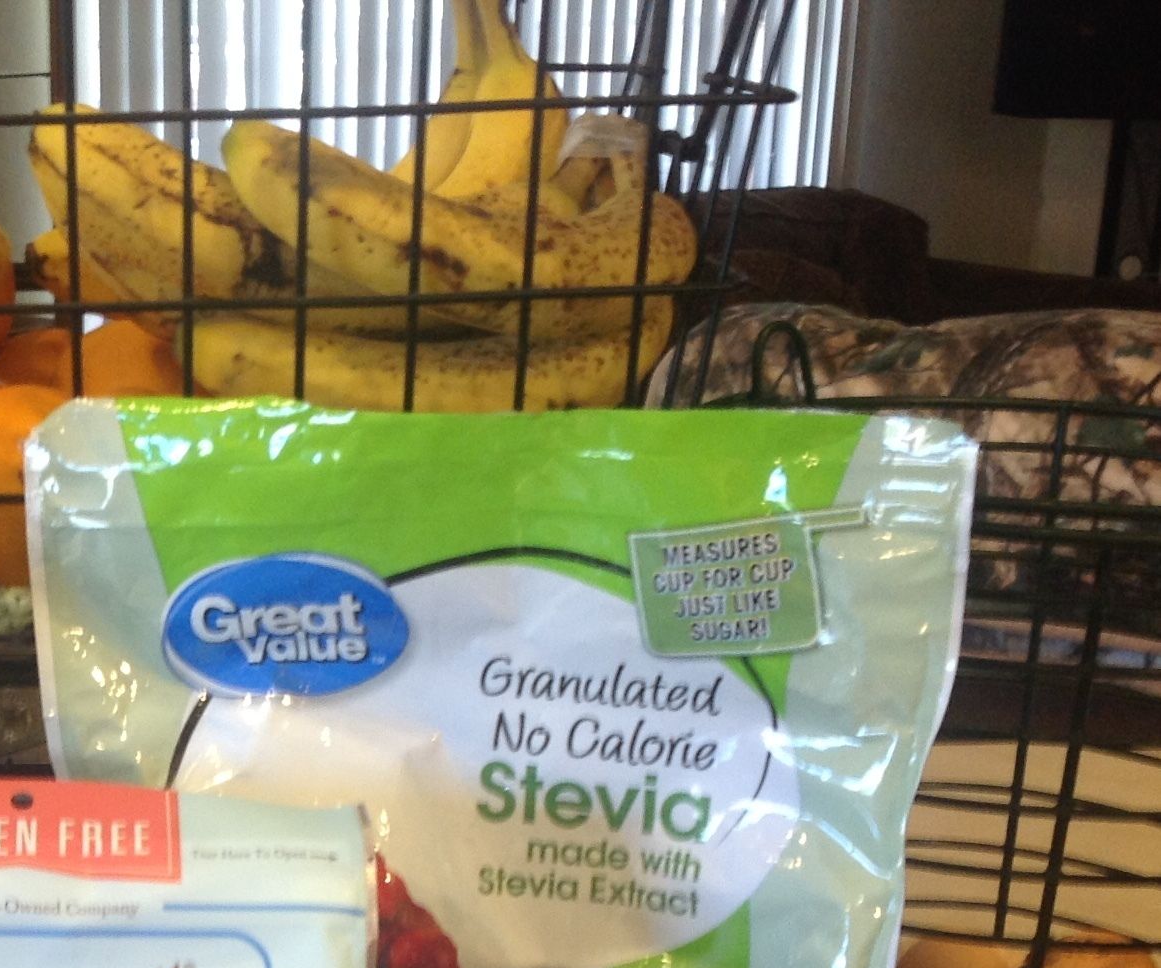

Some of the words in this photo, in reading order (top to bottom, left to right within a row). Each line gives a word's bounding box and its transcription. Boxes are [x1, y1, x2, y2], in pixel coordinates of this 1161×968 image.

[662, 533, 778, 567] MEASURES
[653, 571, 694, 593] CUP
[702, 567, 742, 589] FOR
[749, 558, 795, 583] CUP
[190, 591, 365, 644] Great
[675, 595, 725, 618] JUST
[732, 589, 778, 613] LIKE
[234, 630, 368, 664] Value
[691, 617, 768, 642] SUGAR!
[479, 656, 723, 716] Granulated
[492, 711, 552, 756] No
[567, 718, 718, 772] Calorie
[477, 761, 711, 843] Stevia
[57, 816, 152, 858] FREE
[527, 839, 630, 870] made
[641, 848, 702, 882] with
[66, 899, 139, 919] Company
[478, 866, 578, 900] Stevia
[590, 876, 699, 918] Extract
